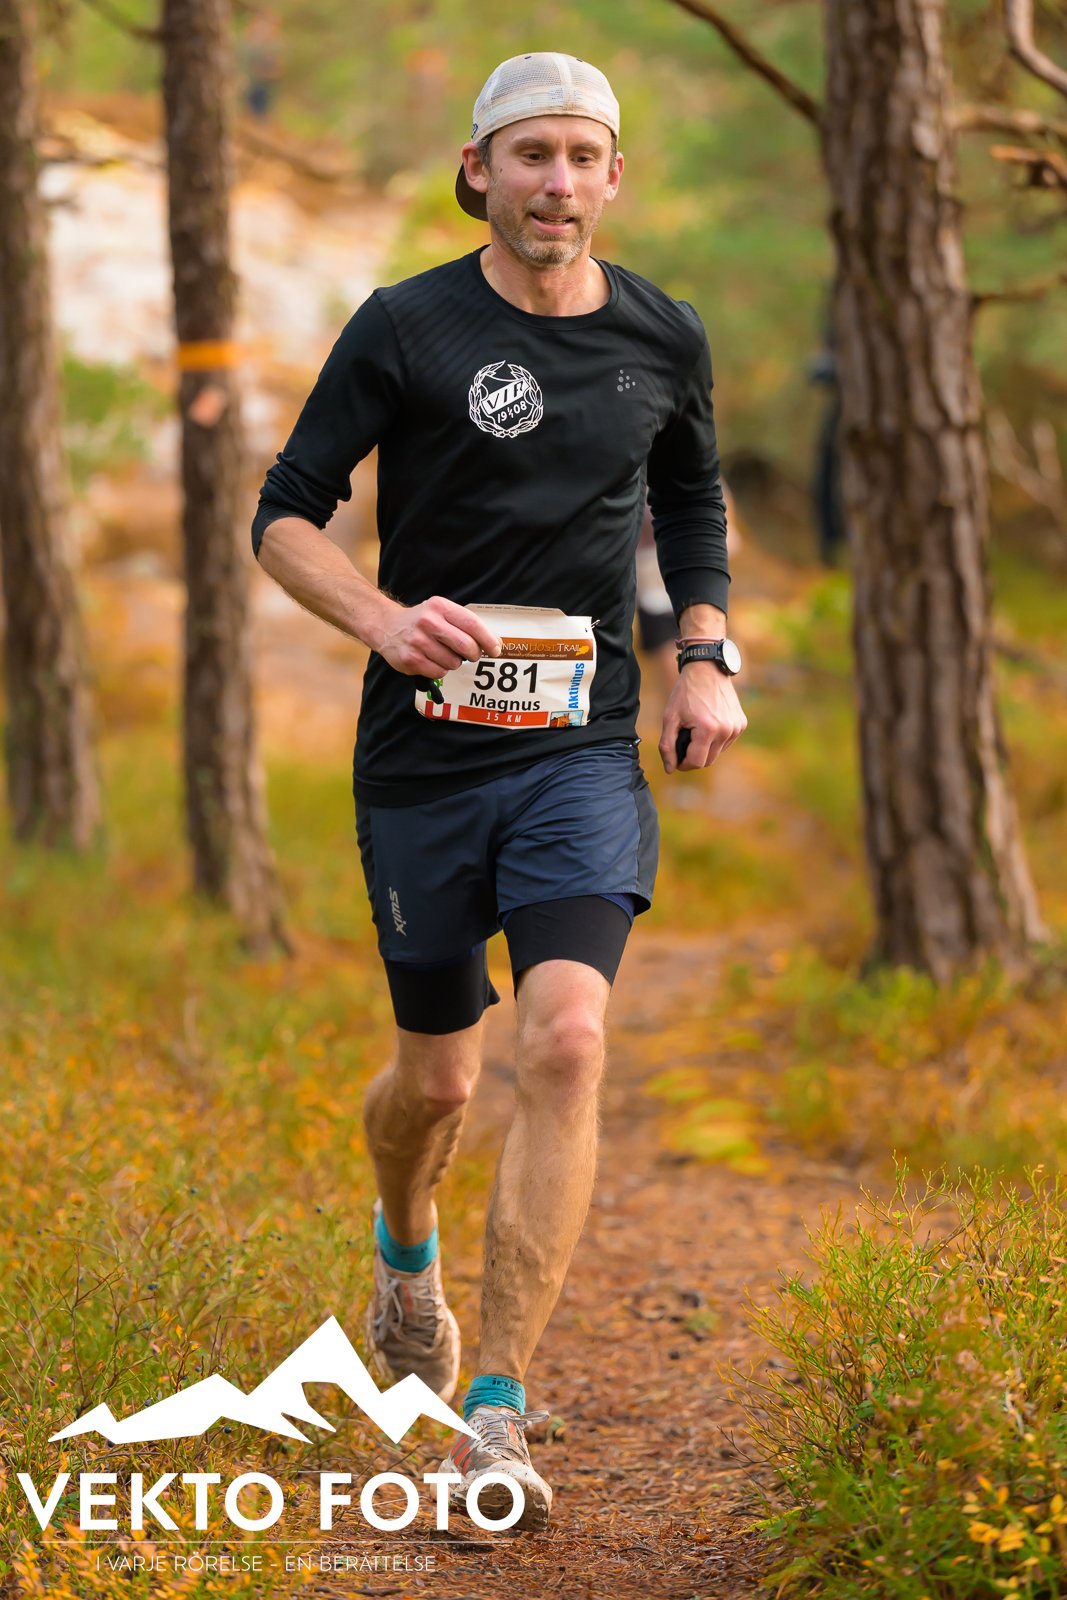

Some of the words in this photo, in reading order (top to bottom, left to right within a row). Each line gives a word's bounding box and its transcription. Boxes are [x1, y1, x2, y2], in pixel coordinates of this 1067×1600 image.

[500, 642, 529, 651] NDAN
[473, 661, 538, 694] 581
[568, 662, 585, 709] Aktivitus
[469, 693, 540, 713] Magnus
[506, 714, 522, 723] KM
